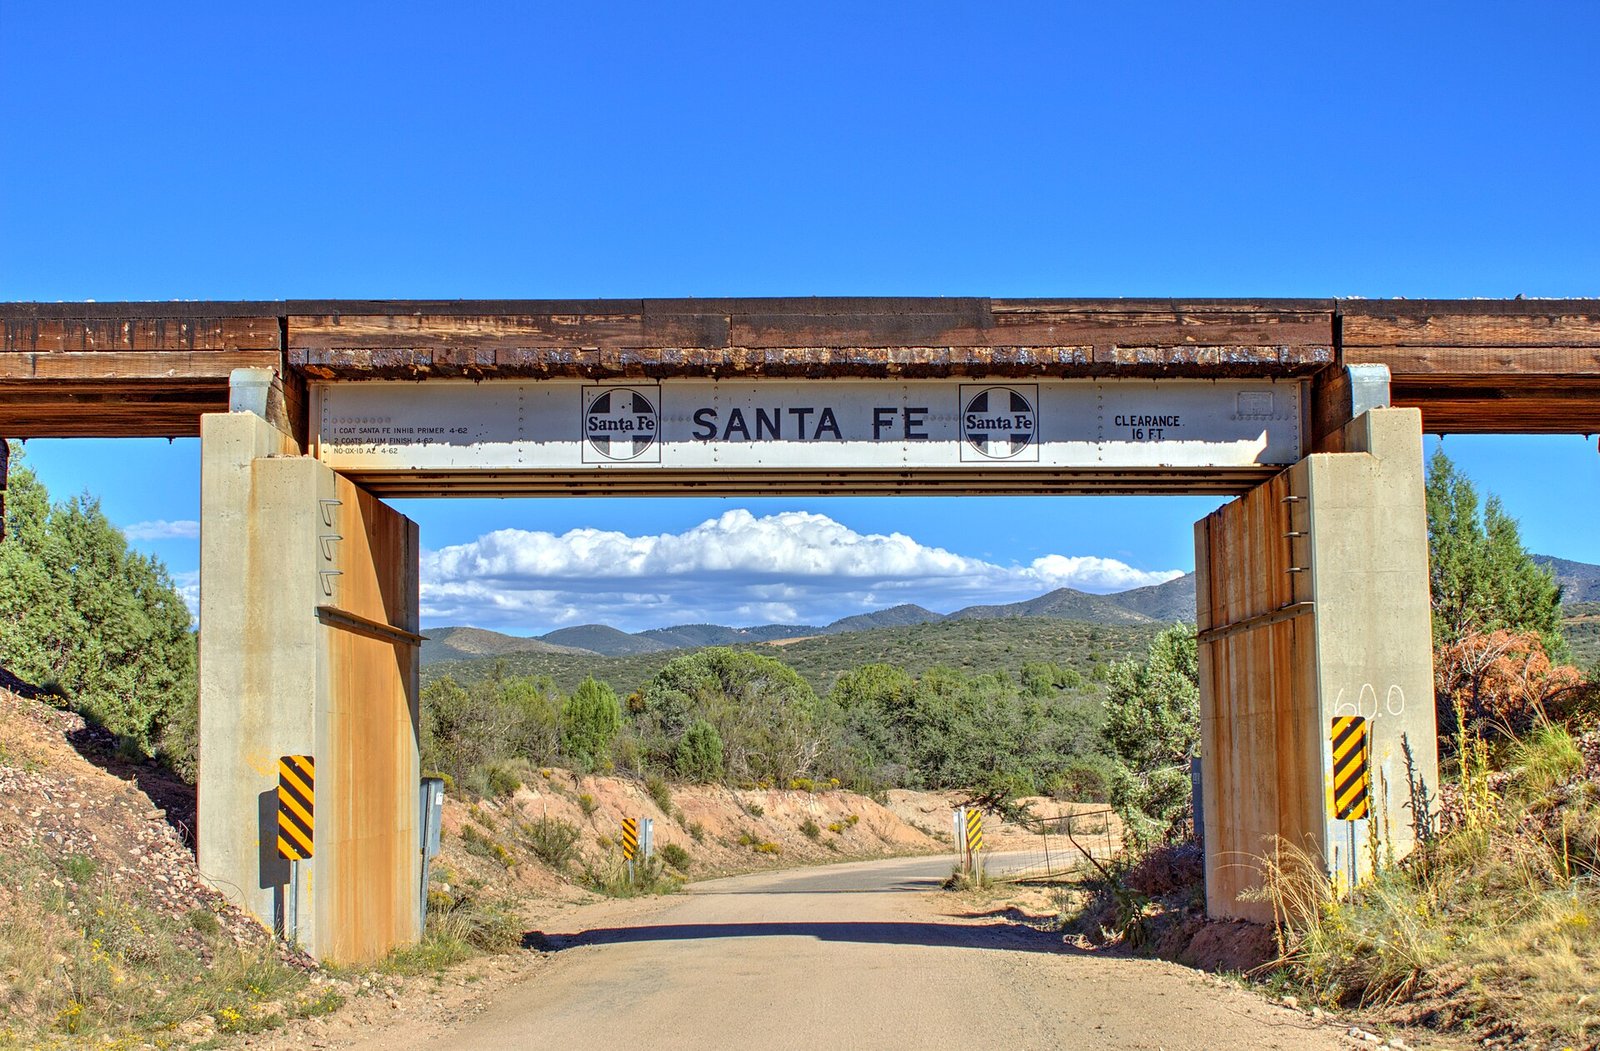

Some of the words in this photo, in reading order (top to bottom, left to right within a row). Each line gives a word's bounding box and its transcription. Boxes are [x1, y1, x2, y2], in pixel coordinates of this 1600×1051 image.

[588, 416, 634, 431] Santa
[636, 416, 655, 431] Fe
[692, 407, 842, 441] SANTA
[873, 407, 929, 440] FE
[966, 415, 1012, 431] Santa
[1014, 415, 1033, 430] Fe
[1114, 415, 1180, 427] CLEARANCE
[1132, 428, 1144, 440] 16
[1149, 428, 1165, 440] FT.
[380, 447, 398, 455] 4-62
[1334, 683, 1405, 720] 60.0
